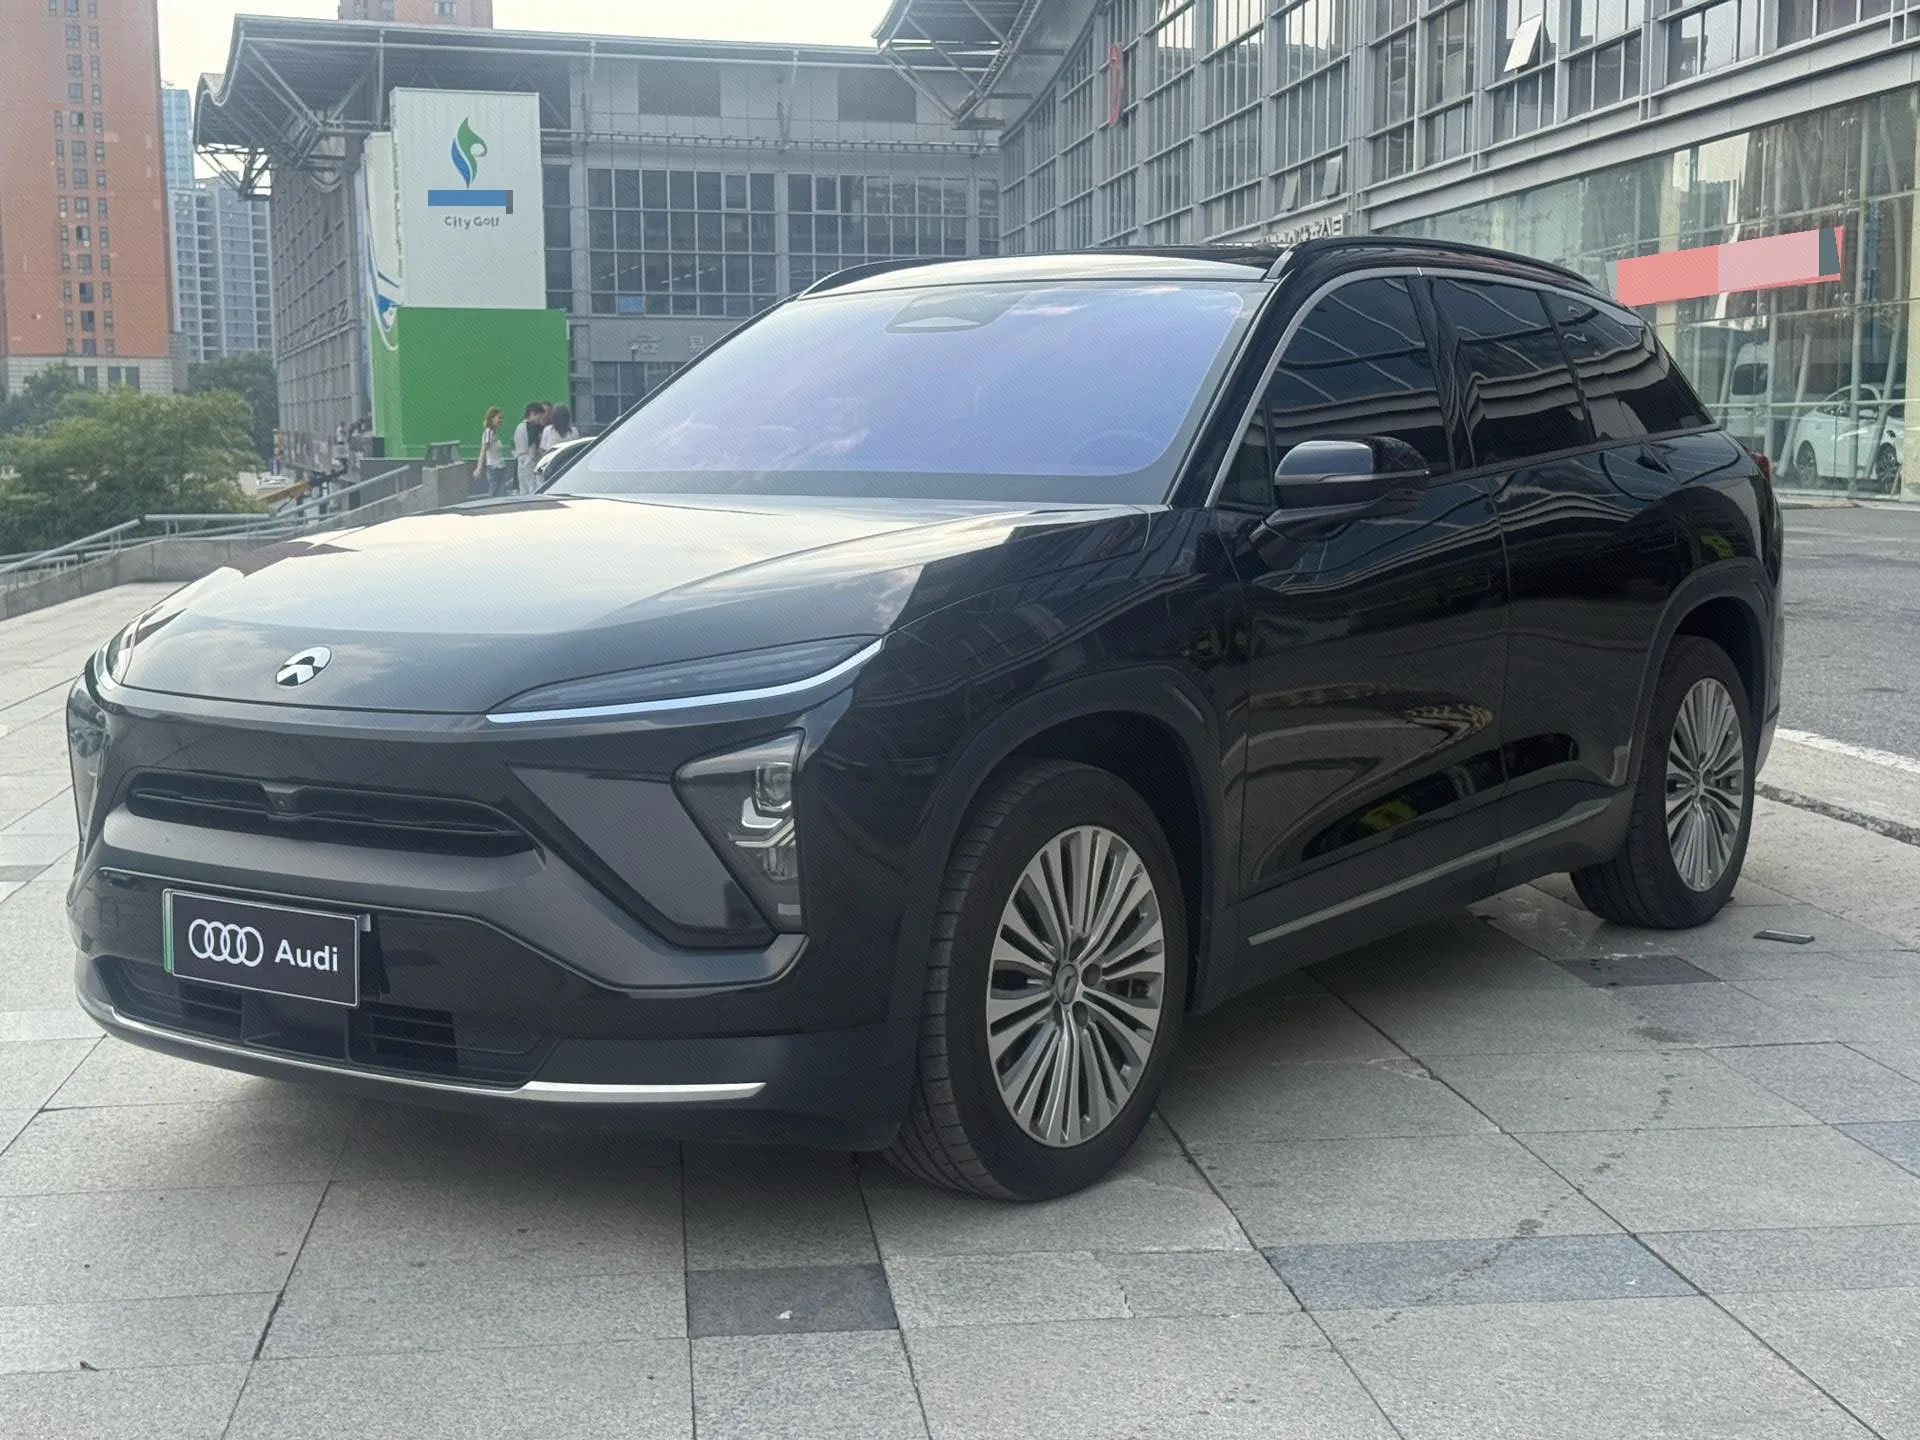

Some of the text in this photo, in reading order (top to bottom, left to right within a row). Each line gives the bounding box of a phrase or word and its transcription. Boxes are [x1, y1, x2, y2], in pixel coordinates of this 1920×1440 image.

[444, 216, 500, 230] City Golf
[274, 939, 338, 972] Audi
